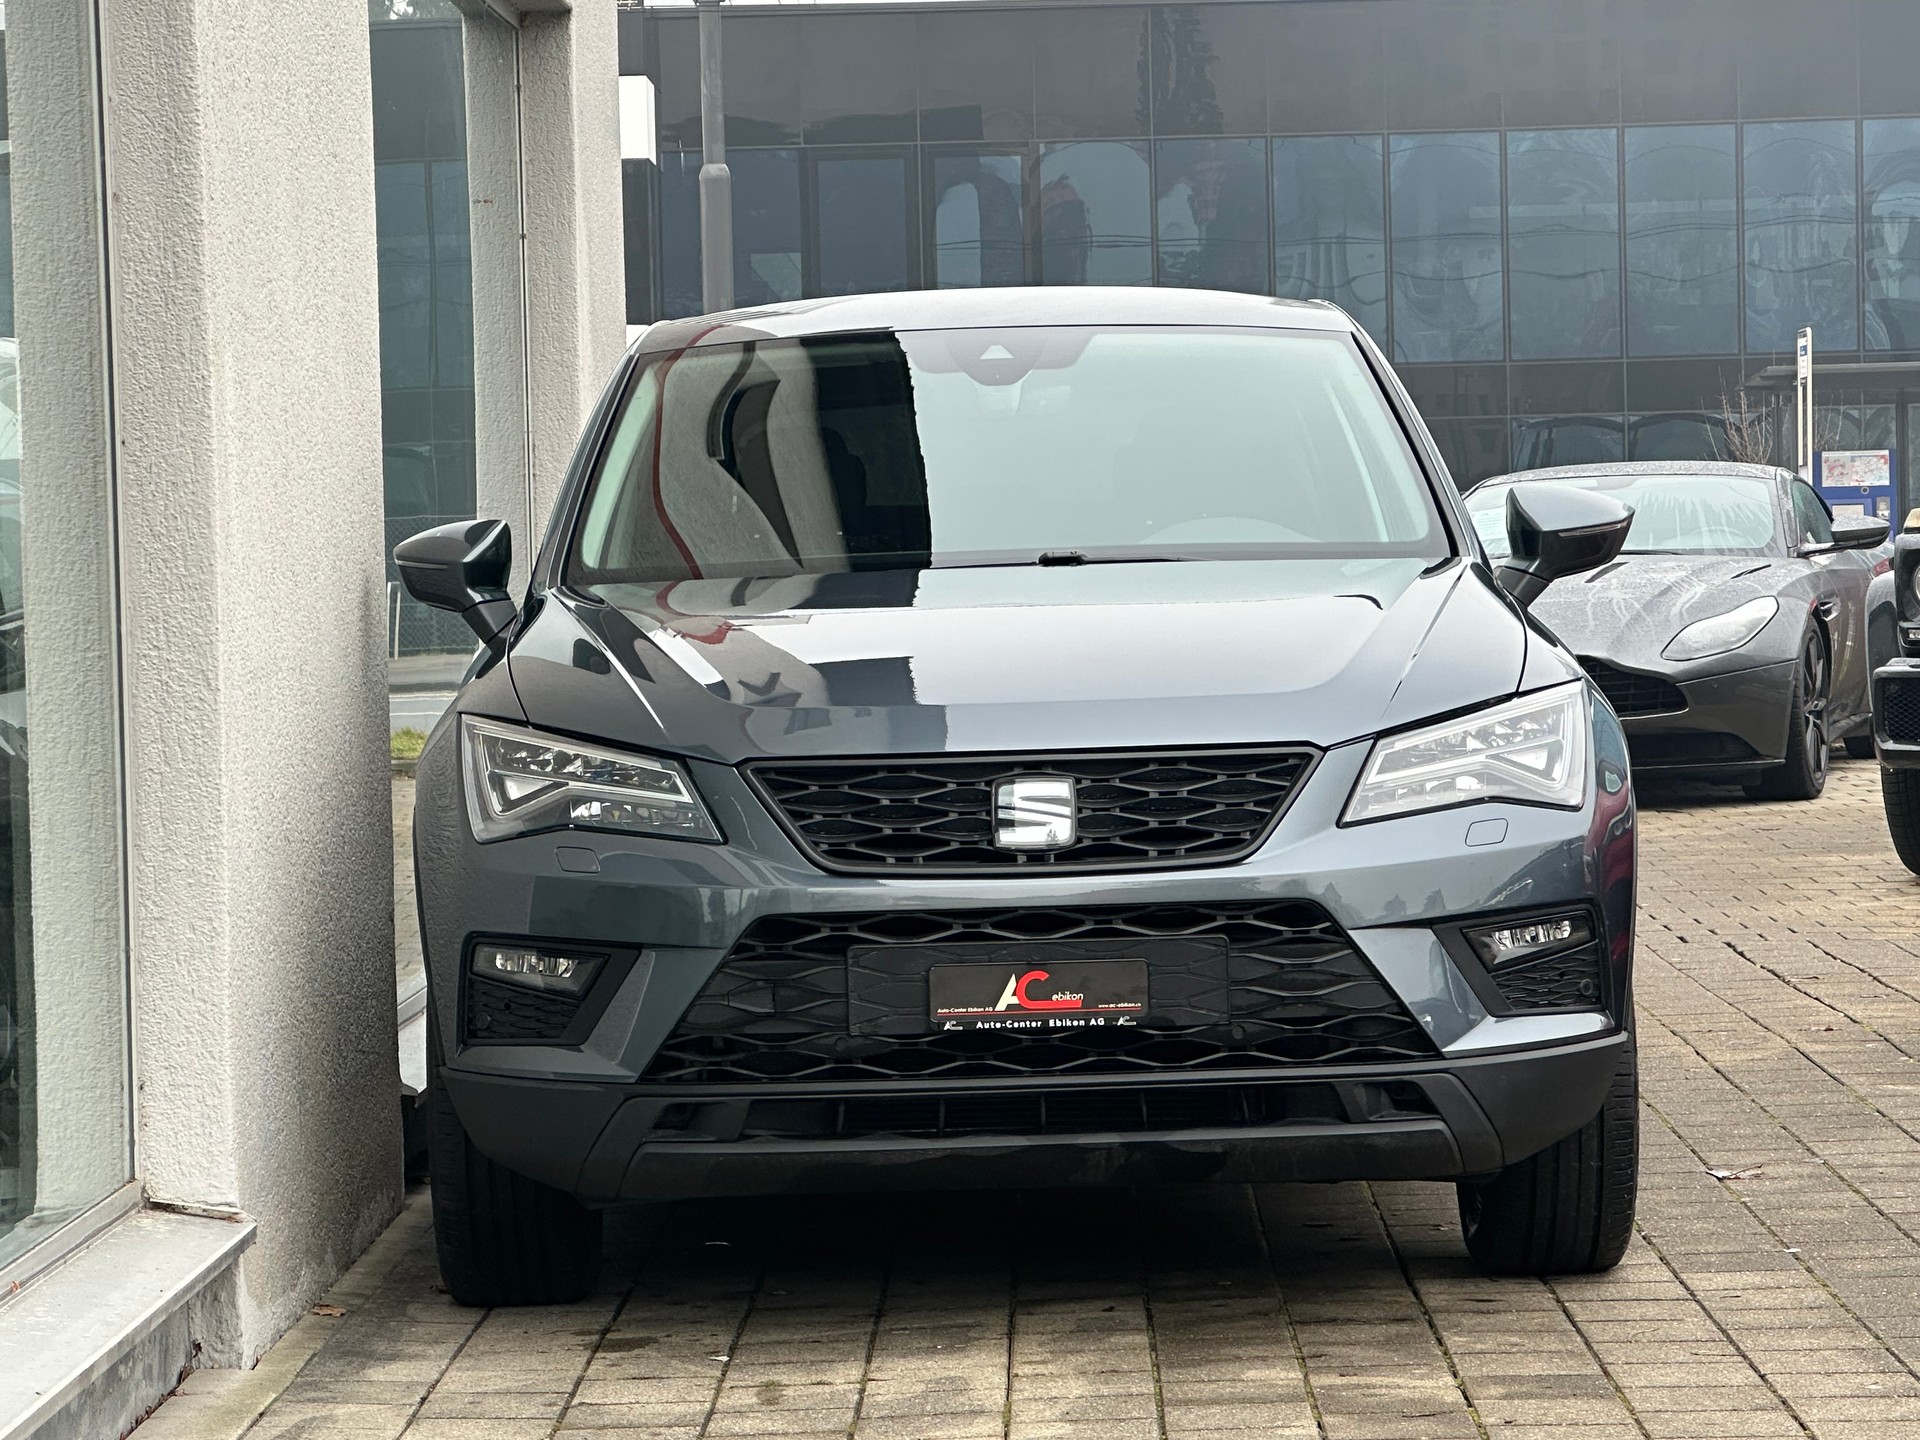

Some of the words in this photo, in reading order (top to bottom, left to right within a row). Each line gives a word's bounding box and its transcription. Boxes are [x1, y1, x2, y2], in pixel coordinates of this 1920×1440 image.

[1052, 991, 1084, 1002] ebikon
[976, 1020, 1042, 1029] Auto-Center
[1049, 1018, 1085, 1027] Ebikon
[1089, 1017, 1105, 1026] AG
